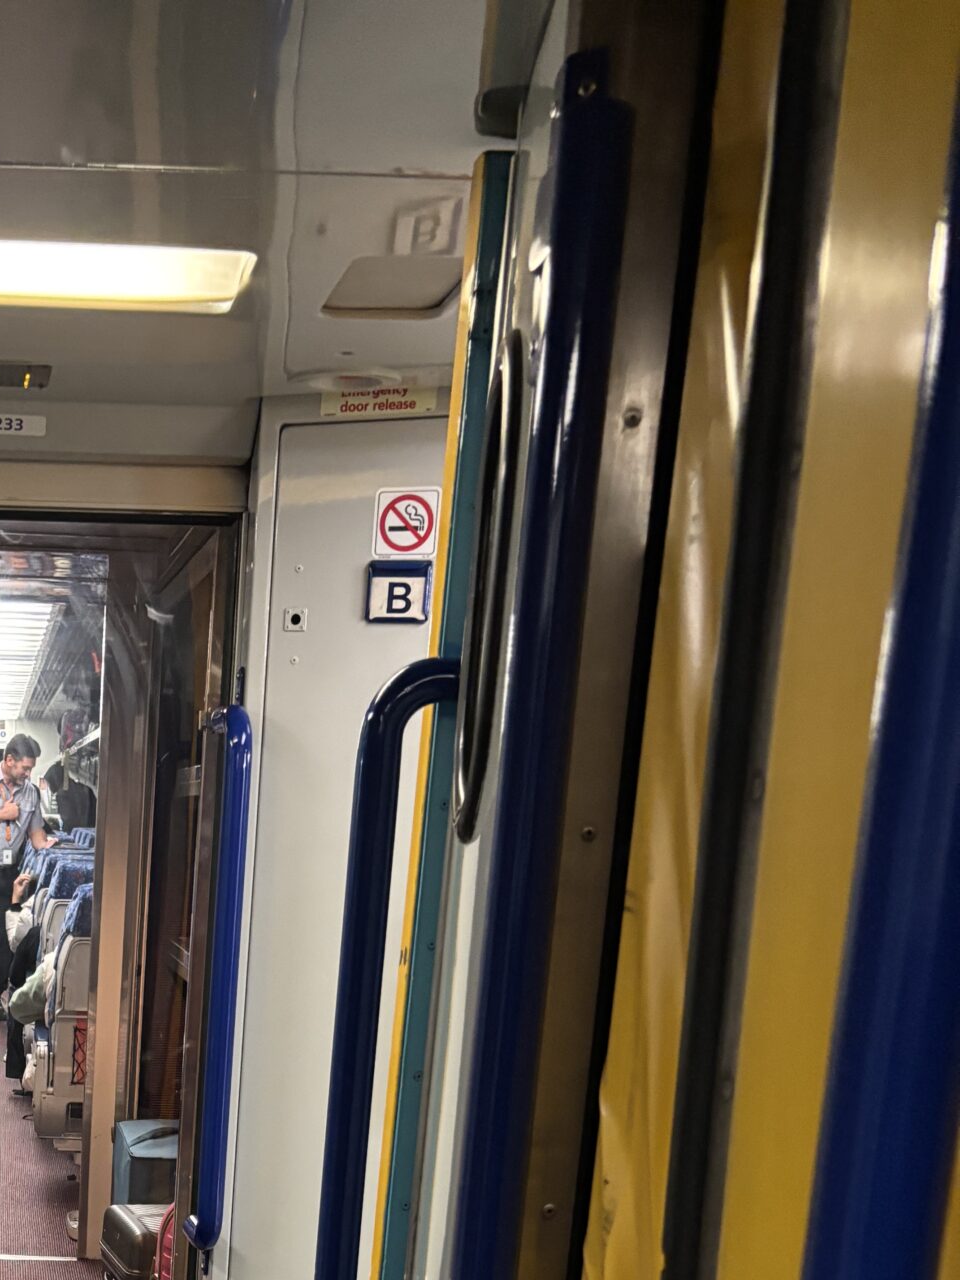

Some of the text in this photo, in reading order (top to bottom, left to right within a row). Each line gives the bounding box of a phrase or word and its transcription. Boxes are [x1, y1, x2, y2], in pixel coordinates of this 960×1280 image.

[340, 398, 417, 413] door release
[386, 582, 412, 614] B
